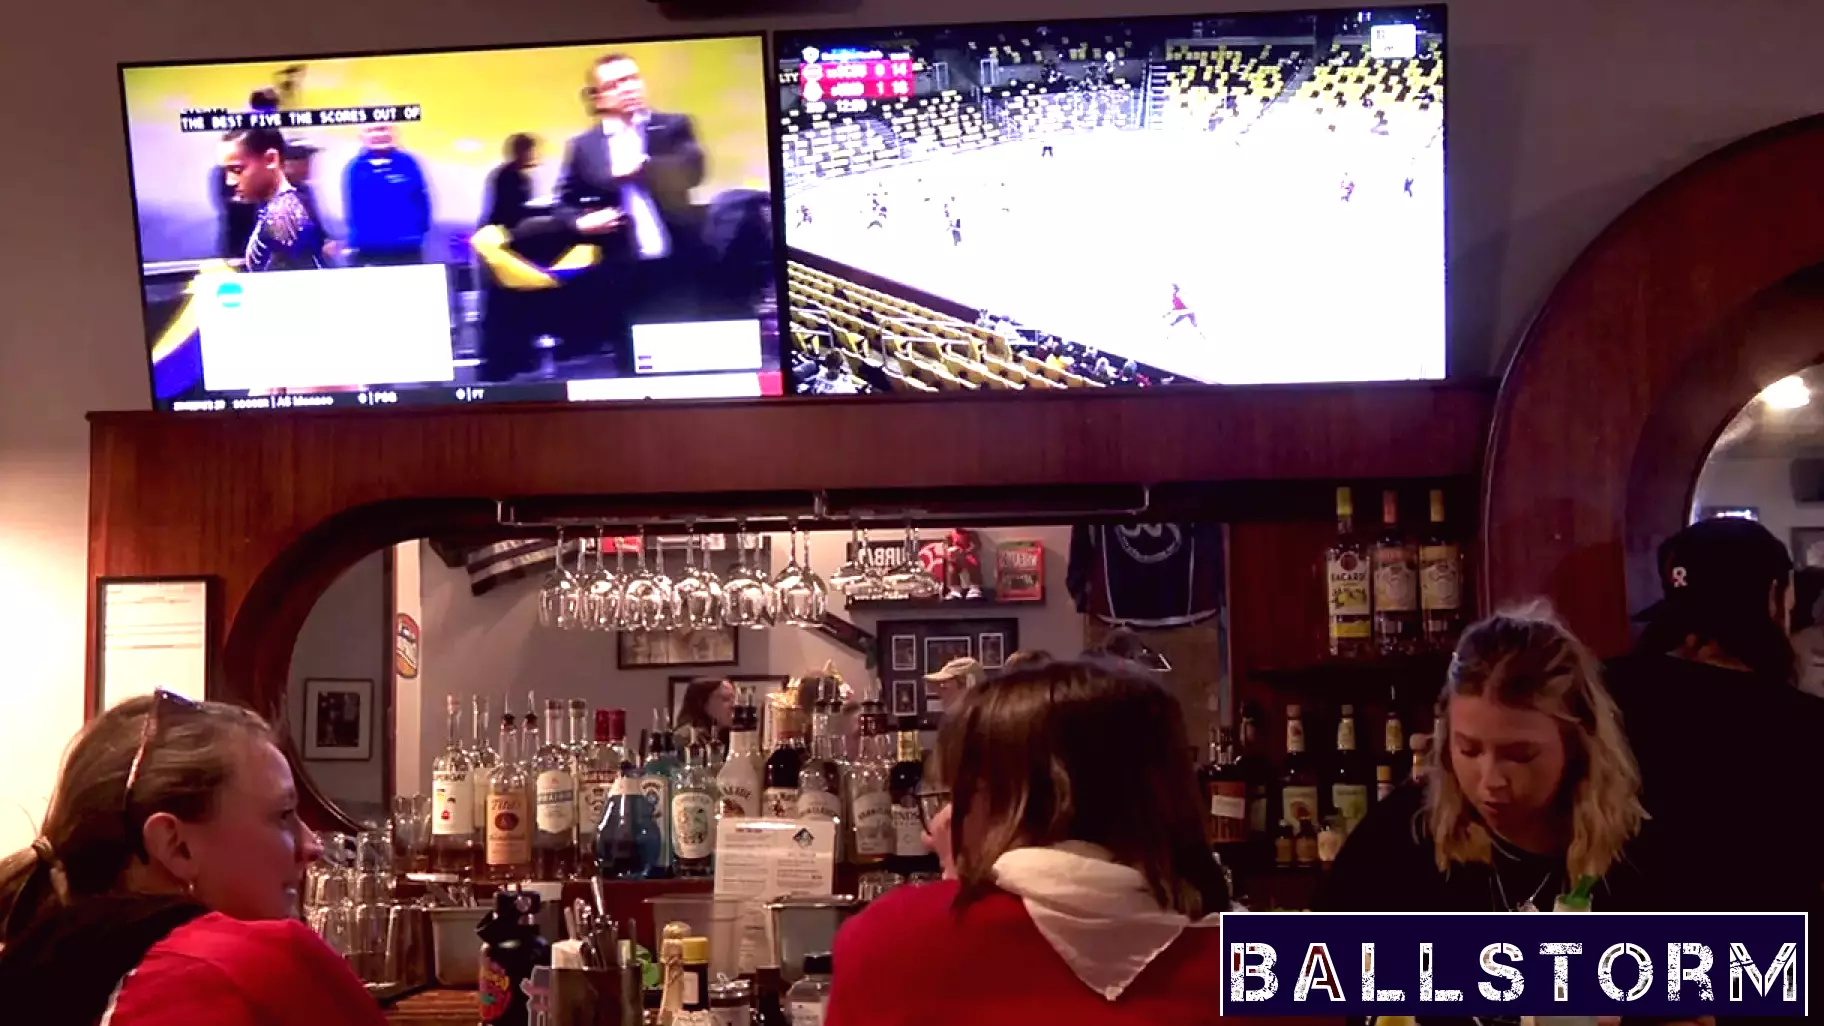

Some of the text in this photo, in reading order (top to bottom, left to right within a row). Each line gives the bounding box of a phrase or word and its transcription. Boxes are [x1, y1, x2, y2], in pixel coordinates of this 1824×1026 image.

[182, 107, 420, 130] THE BEST FIVE THE SCORES OUT OF
